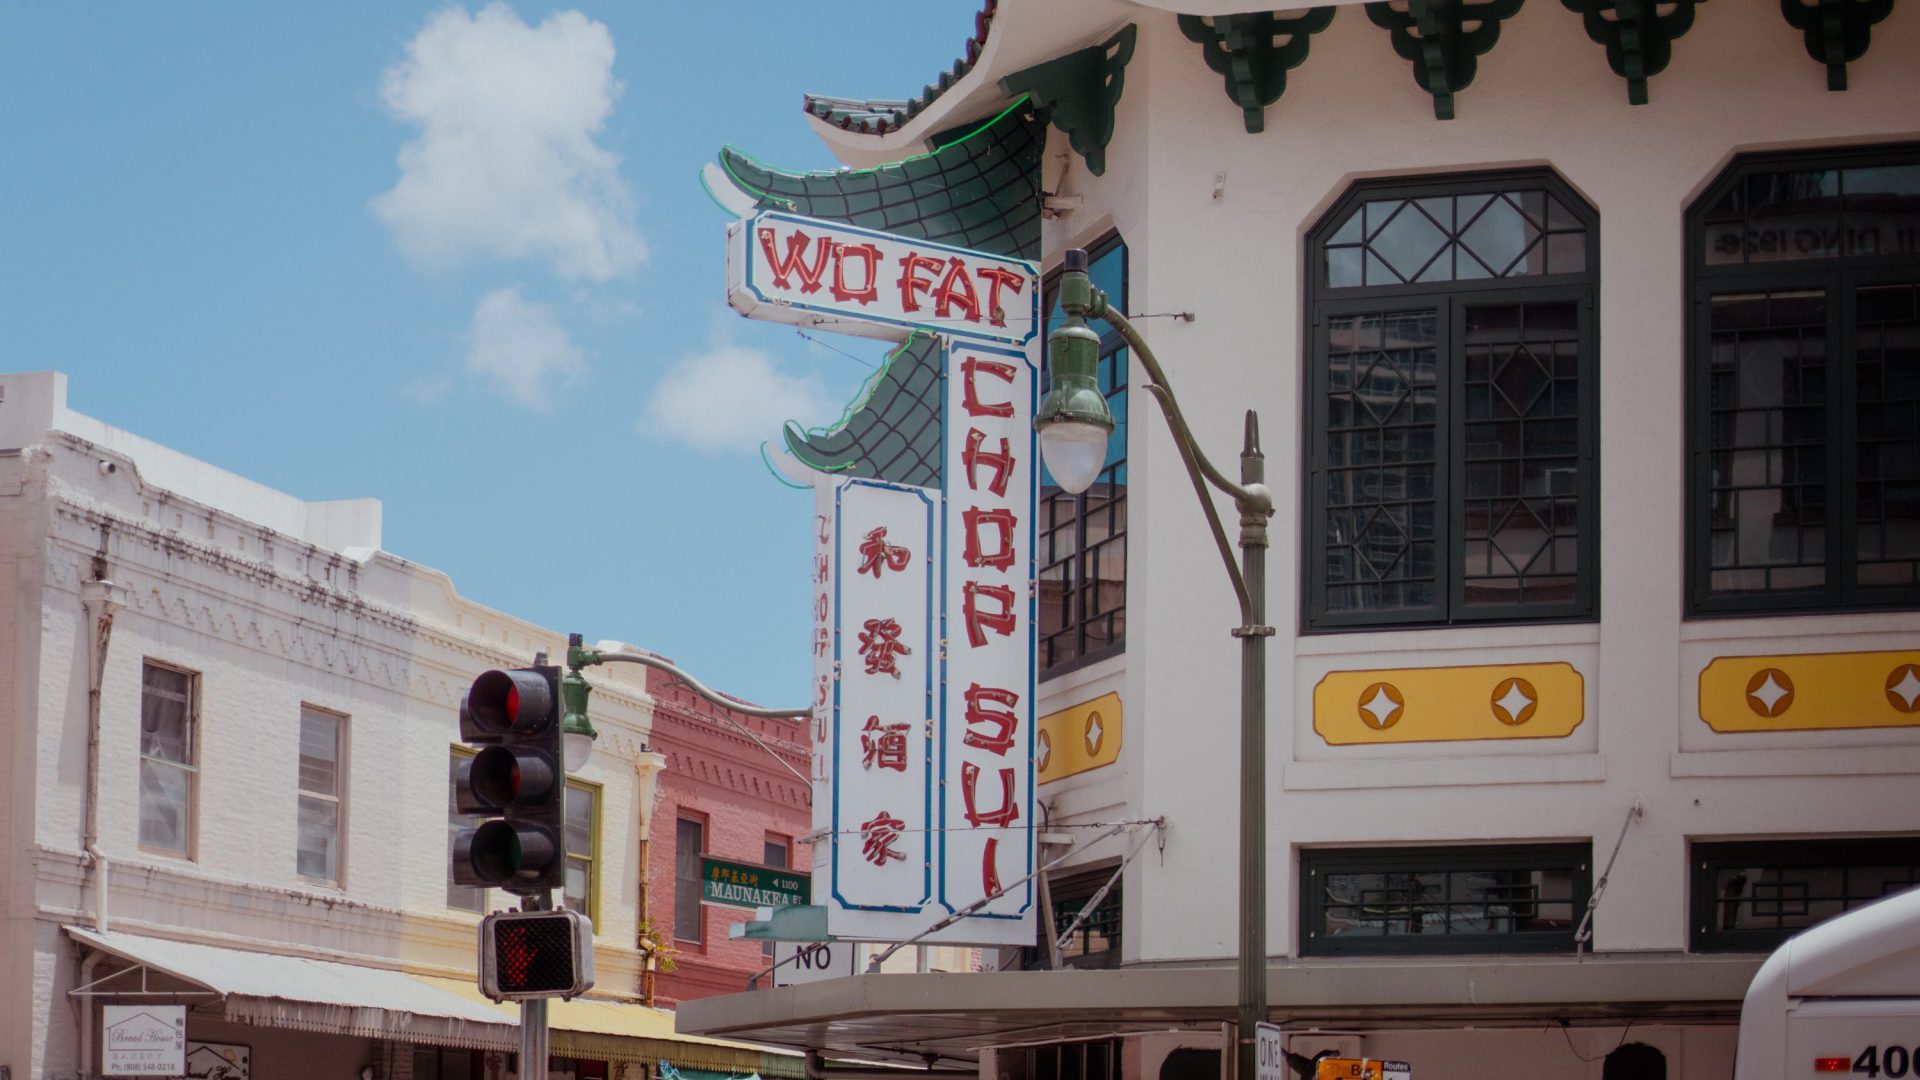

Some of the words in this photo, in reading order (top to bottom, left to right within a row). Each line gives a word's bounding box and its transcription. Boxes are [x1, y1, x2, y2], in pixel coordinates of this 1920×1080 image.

[758, 228, 884, 305] WO
[897, 252, 1025, 328] FAT
[961, 356, 1017, 649] CHOP
[857, 526, 912, 867] 和發酒家
[962, 682, 1019, 899] SUI
[711, 882, 789, 906] MAUNAKEA
[792, 895, 803, 905] ST
[782, 880, 799, 890] 1100
[796, 945, 831, 970] NO
[112, 1028, 144, 1043] Bread
[145, 1027, 174, 1043] House
[1260, 1037, 1279, 1068] ONE
[1384, 1062, 1408, 1071] Routes
